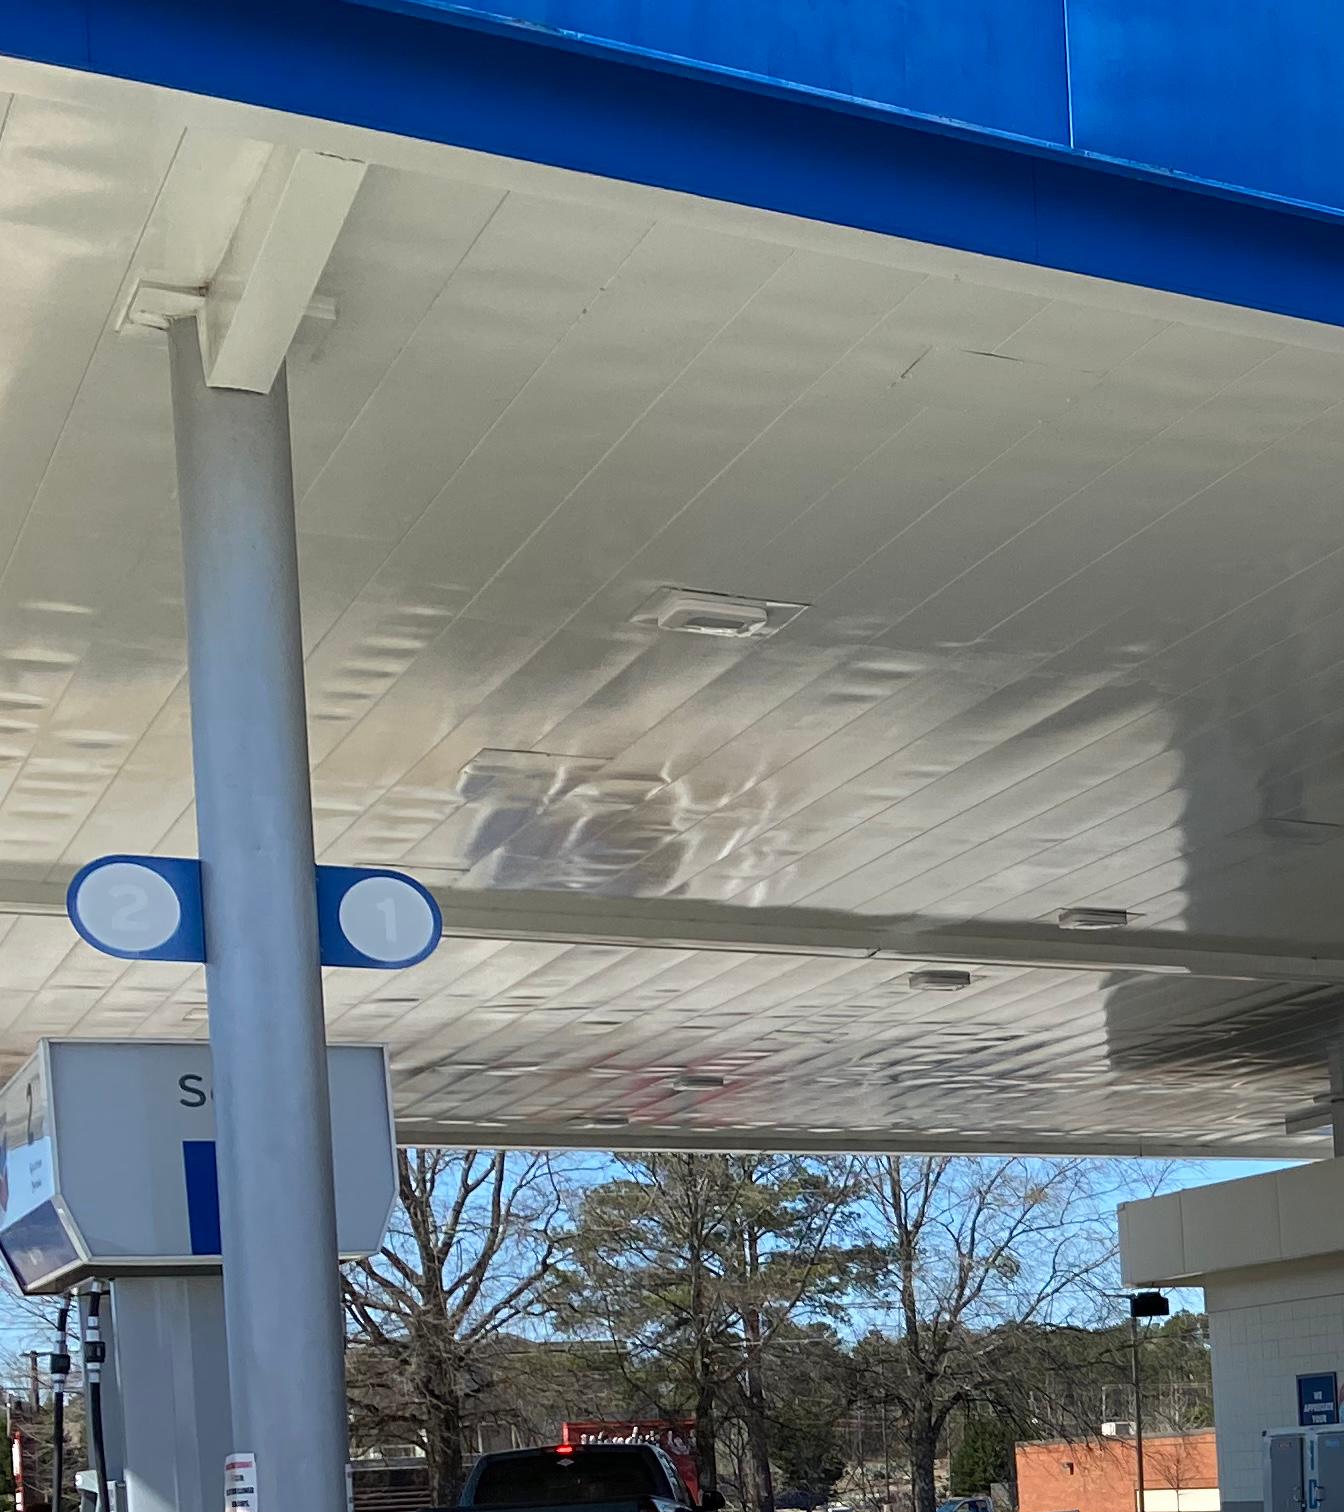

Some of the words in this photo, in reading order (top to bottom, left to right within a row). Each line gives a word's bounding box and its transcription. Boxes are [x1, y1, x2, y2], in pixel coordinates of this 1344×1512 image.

[107, 883, 151, 931] 2
[375, 897, 397, 943] 1
[178, 1074, 214, 1108] S
